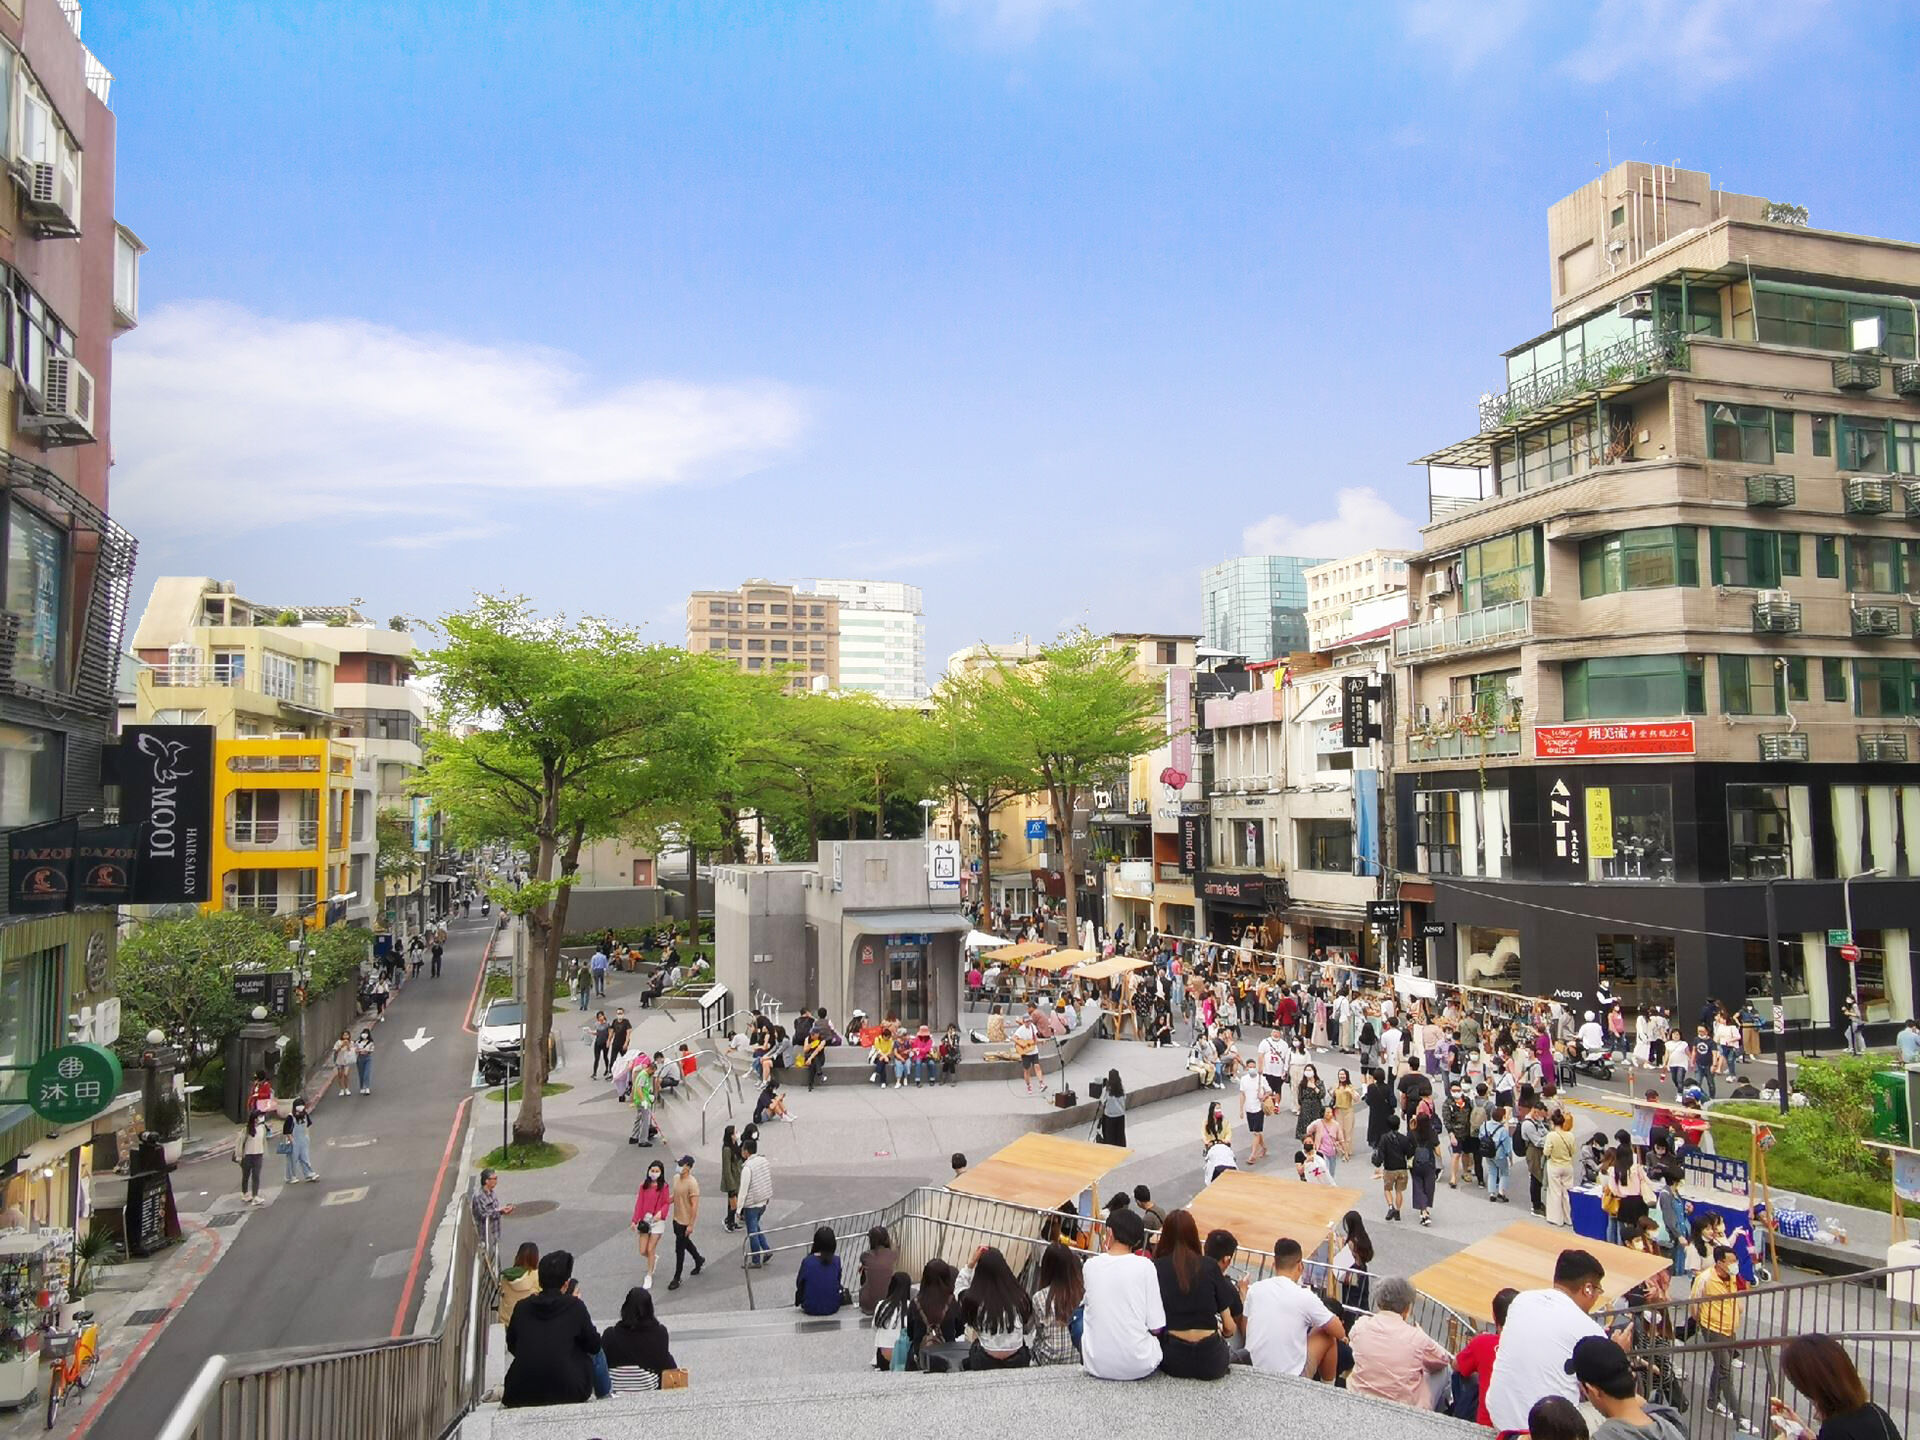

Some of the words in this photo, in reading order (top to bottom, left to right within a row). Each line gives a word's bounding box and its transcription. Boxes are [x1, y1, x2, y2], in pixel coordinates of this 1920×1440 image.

[150, 785, 177, 859] MOOI
[1550, 778, 1571, 857] ANTI
[1571, 829, 1580, 864] SALON
[184, 828, 198, 895] HAIRSALON
[1423, 925, 1445, 934] Aesop
[235, 980, 265, 988] GALERIE
[1553, 988, 1583, 1000] Aesop
[40, 1081, 100, 1101] 沐田
